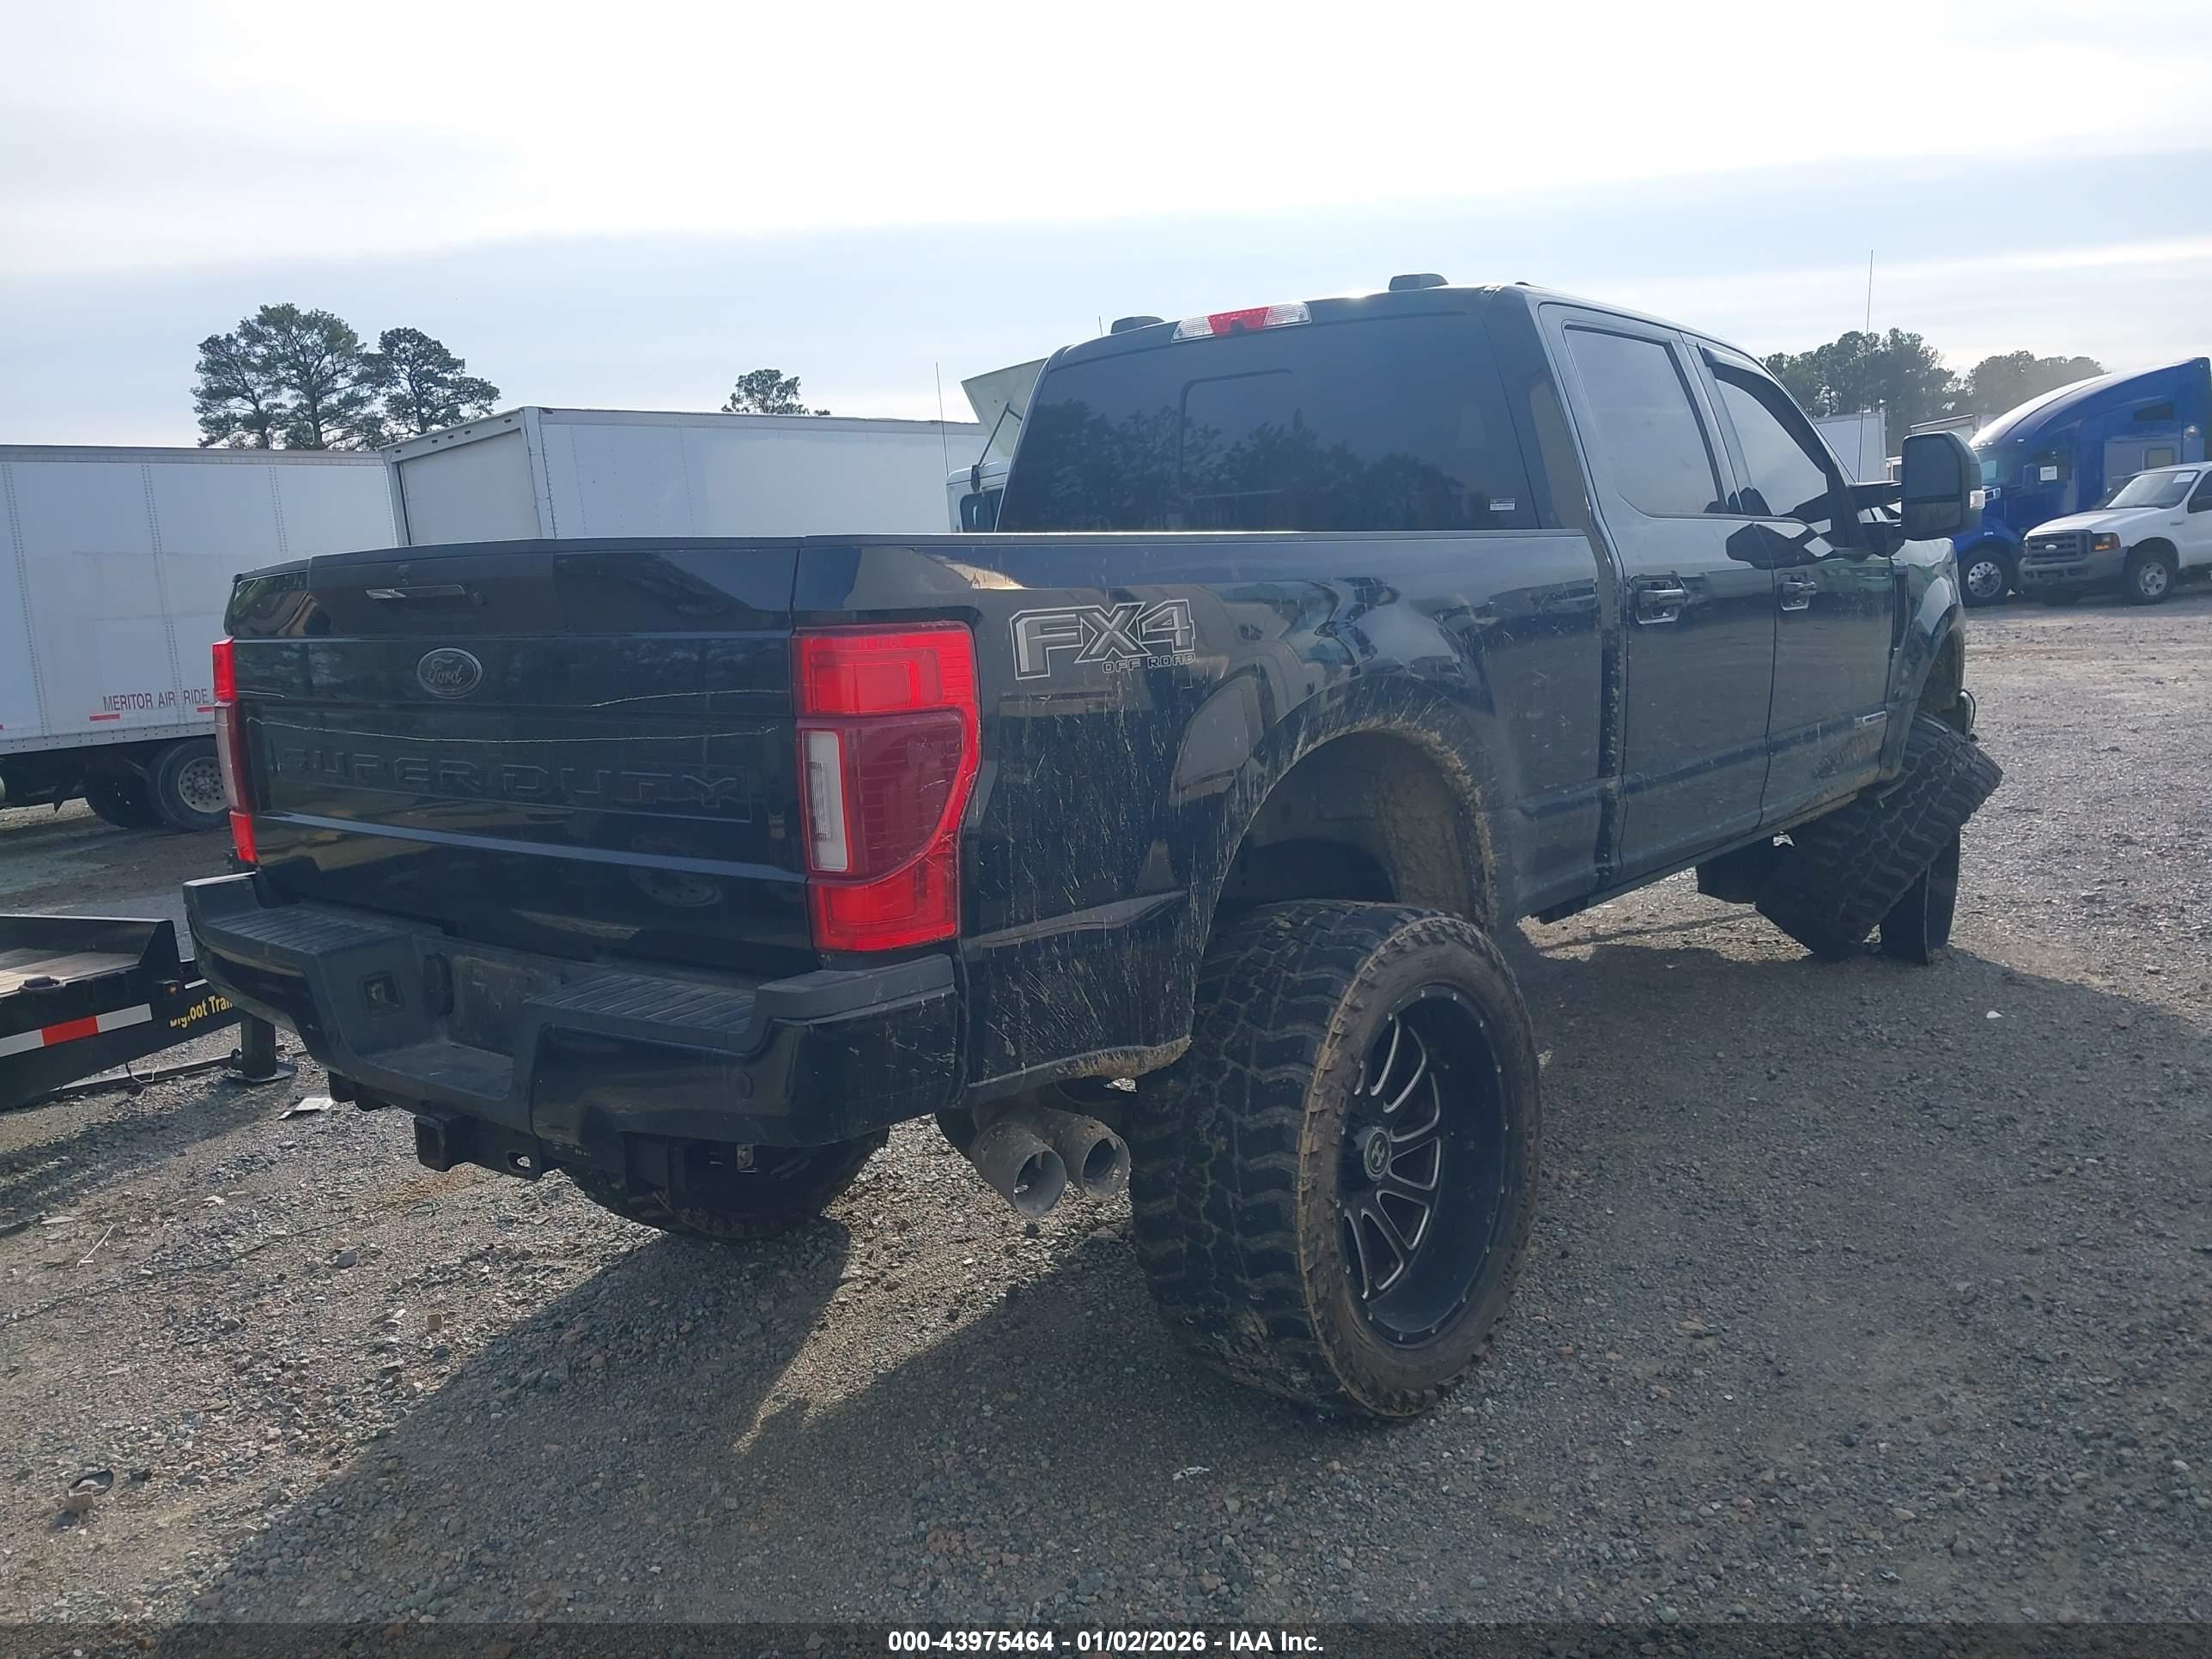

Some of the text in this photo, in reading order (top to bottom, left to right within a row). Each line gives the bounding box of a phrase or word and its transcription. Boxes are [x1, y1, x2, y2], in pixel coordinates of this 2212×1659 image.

[1009, 599, 1196, 681] FX4
[425, 657, 464, 684] Ford
[1102, 652, 1196, 674] OFF ROAD
[102, 689, 208, 712] MERITOR AIR RIDE
[275, 746, 738, 809] SUPER DUTY
